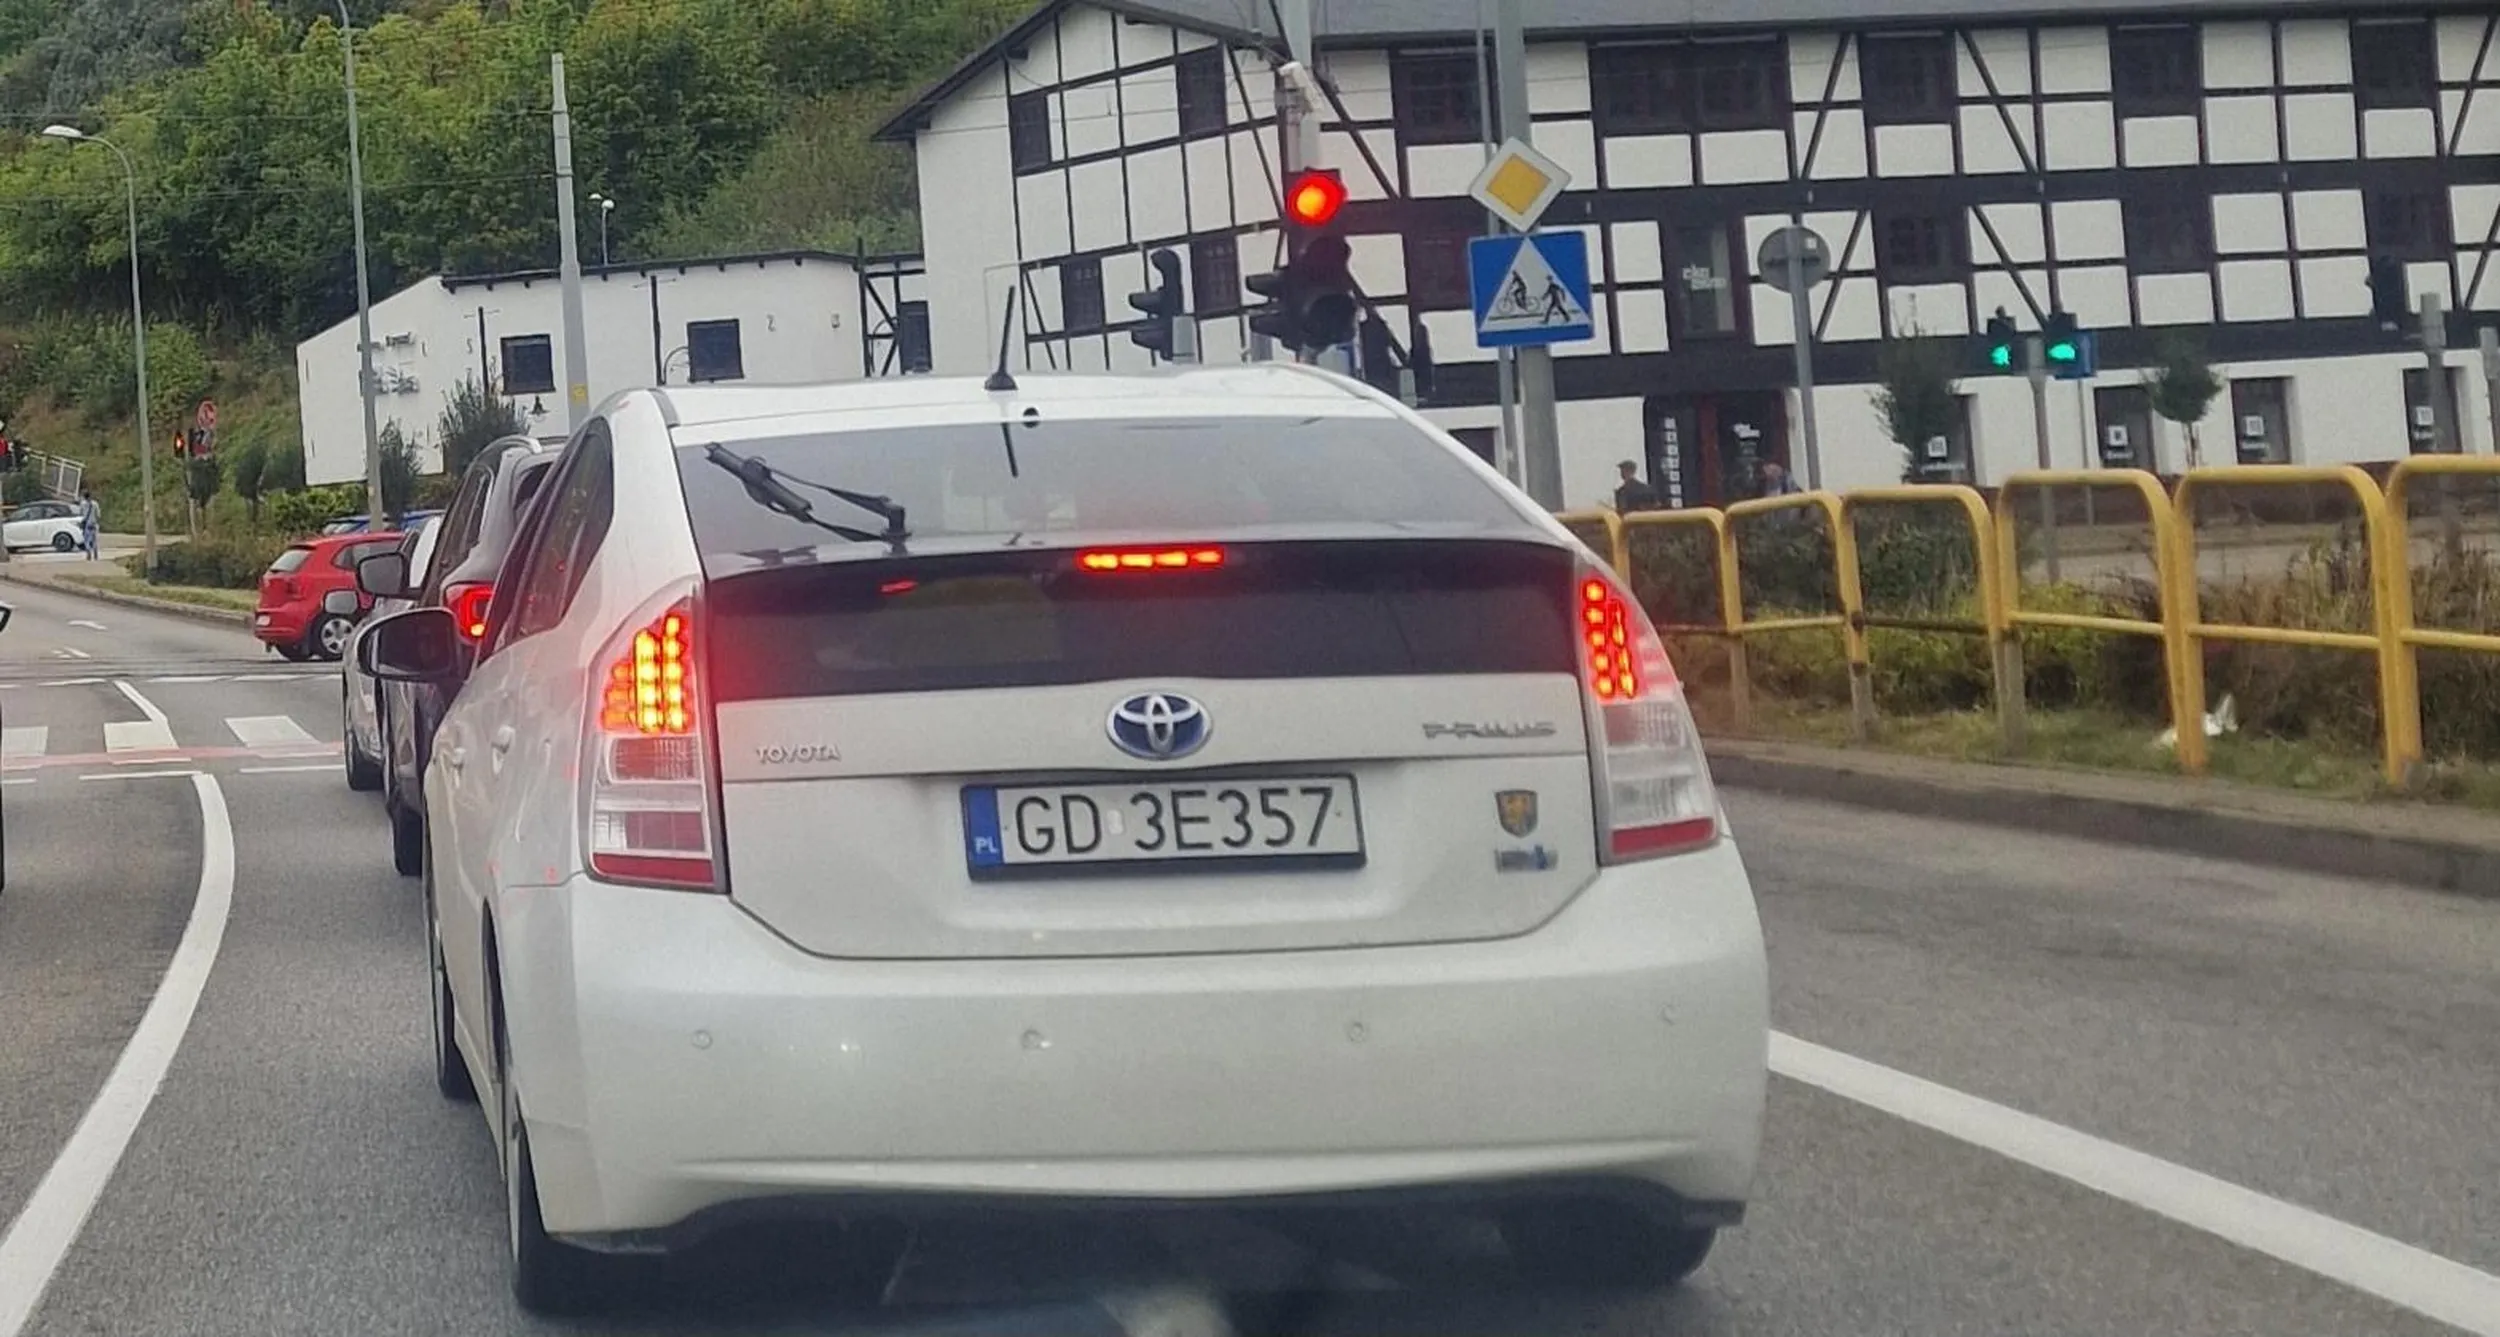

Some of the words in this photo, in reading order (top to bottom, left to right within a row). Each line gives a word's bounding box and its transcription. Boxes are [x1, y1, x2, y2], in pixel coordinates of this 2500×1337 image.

[755, 743, 842, 765] TOYOTA
[1014, 794, 1102, 856] GD
[1129, 786, 1334, 852] 3E357
[974, 835, 998, 855] PL
